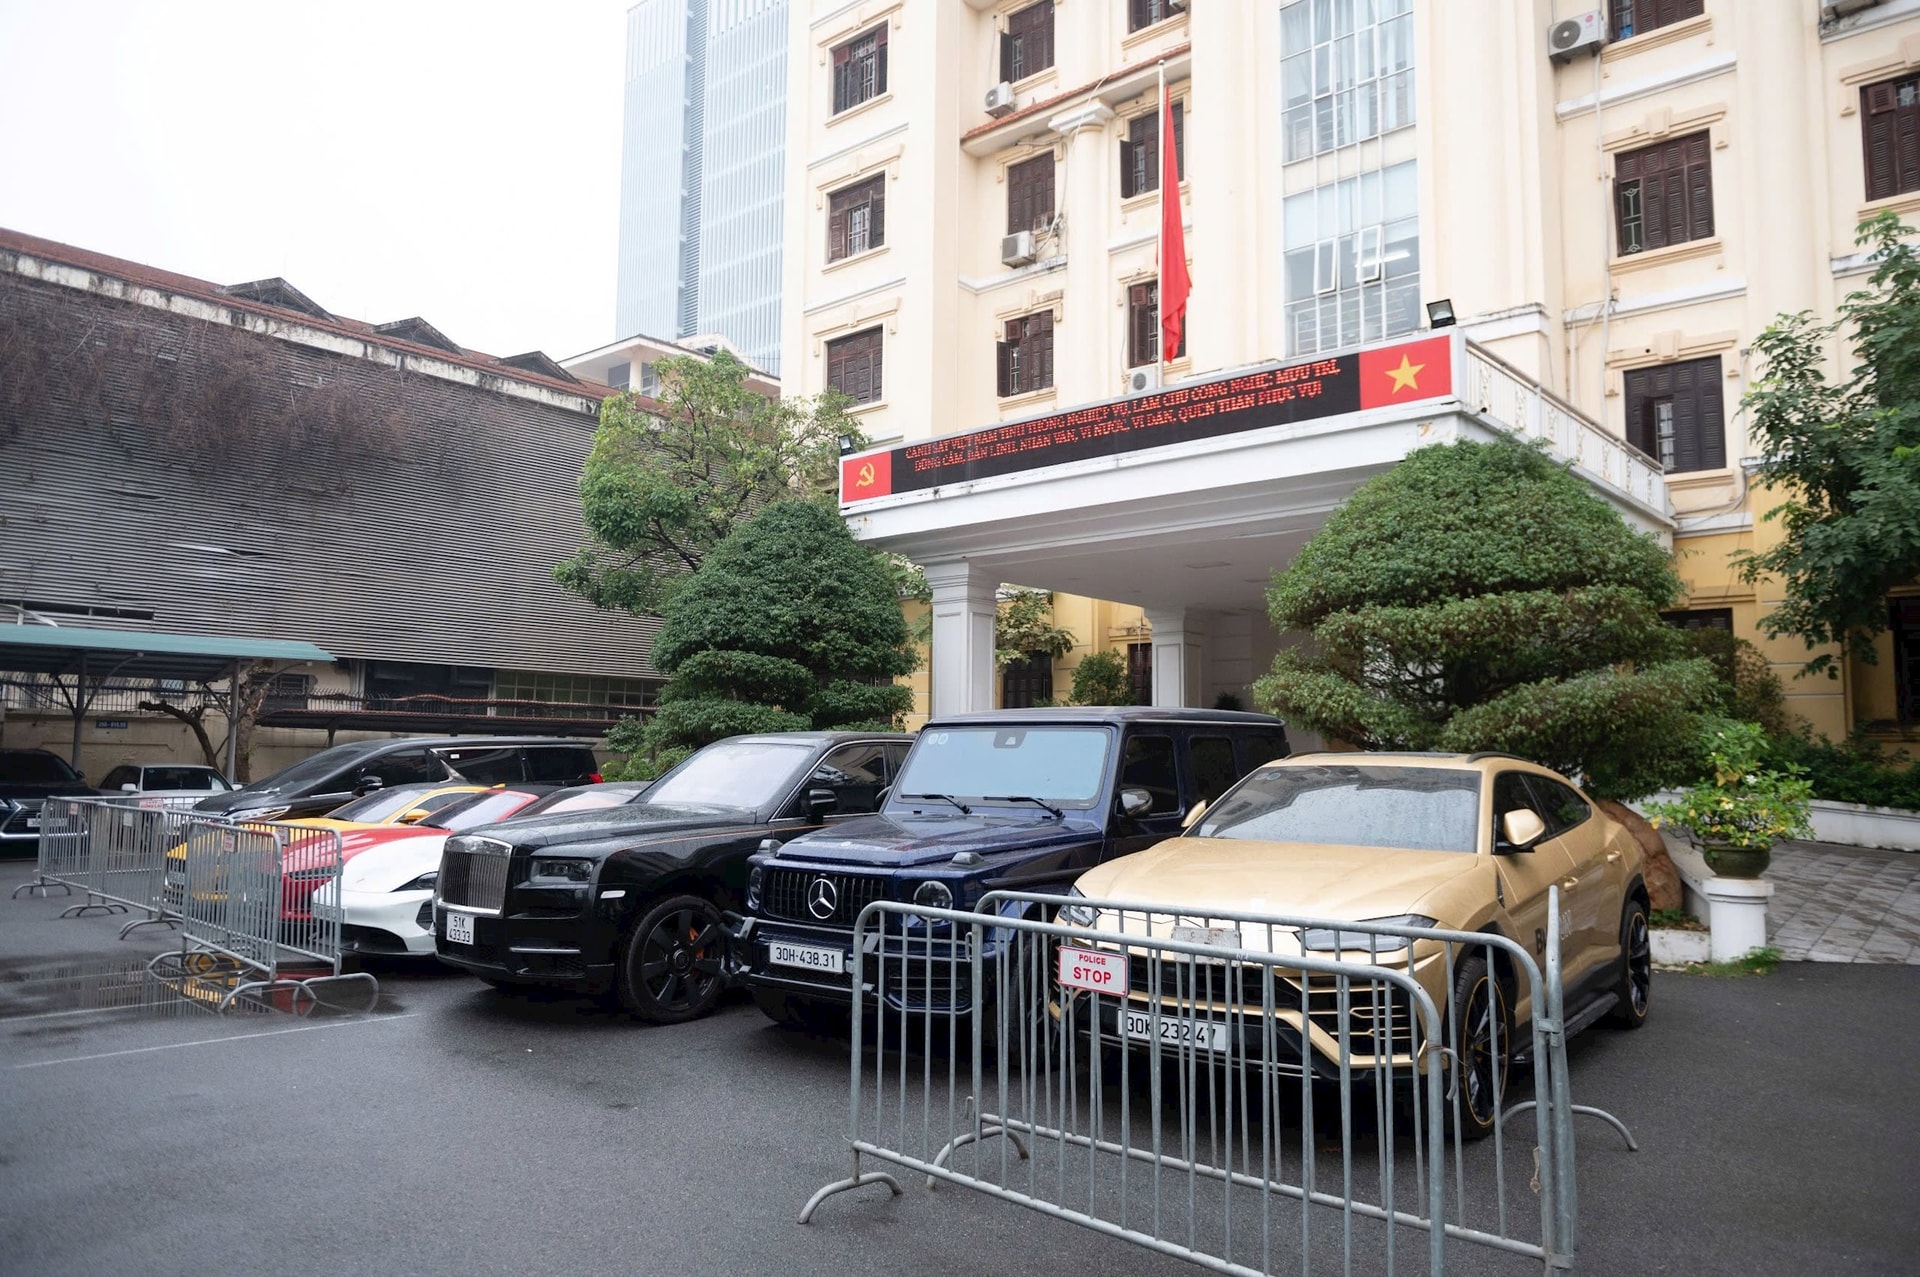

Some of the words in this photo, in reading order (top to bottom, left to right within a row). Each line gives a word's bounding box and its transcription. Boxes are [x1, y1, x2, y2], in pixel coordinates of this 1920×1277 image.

[453, 915, 467, 929] 51K
[775, 946, 835, 968] 30H-438.31
[1079, 954, 1106, 966] POLICE
[1073, 966, 1111, 985] STOP
